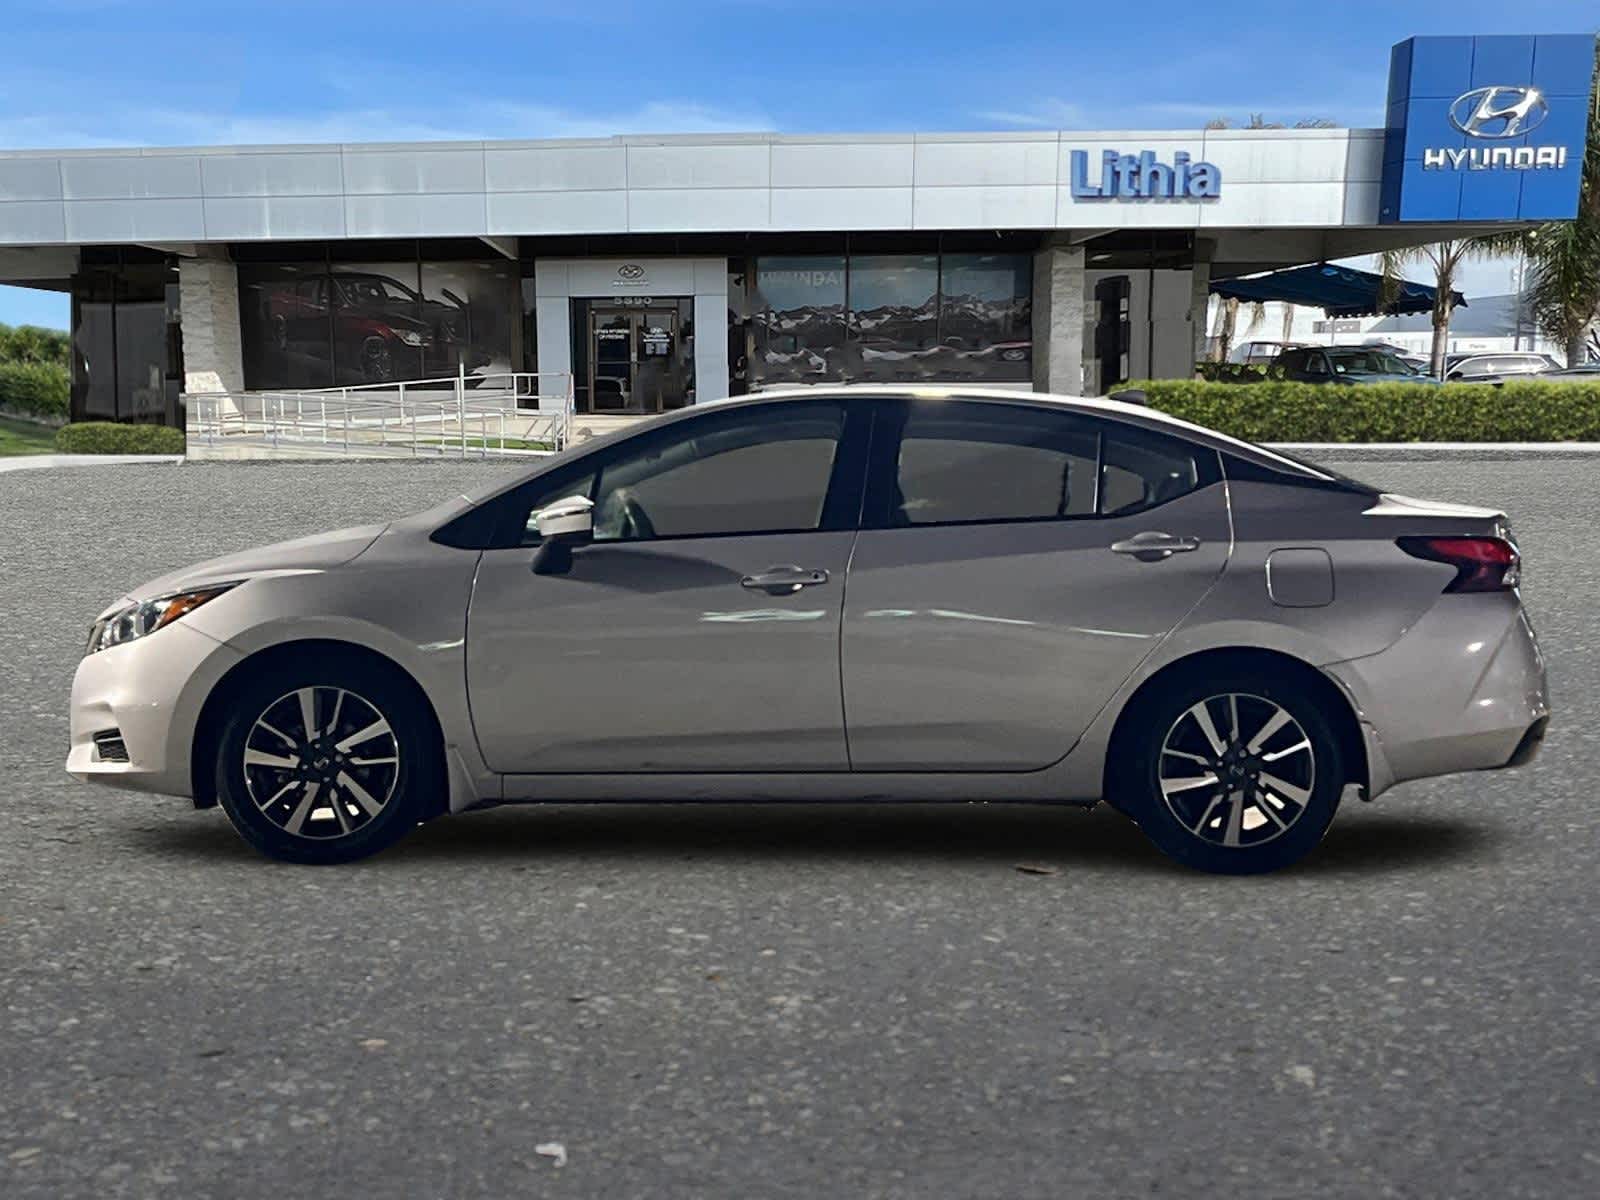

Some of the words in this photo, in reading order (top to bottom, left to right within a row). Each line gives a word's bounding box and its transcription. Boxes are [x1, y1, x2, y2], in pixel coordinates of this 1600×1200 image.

[1423, 147, 1567, 170] HYUNDAI
[1071, 149, 1221, 202] Lithia
[758, 271, 846, 288] HNDAI
